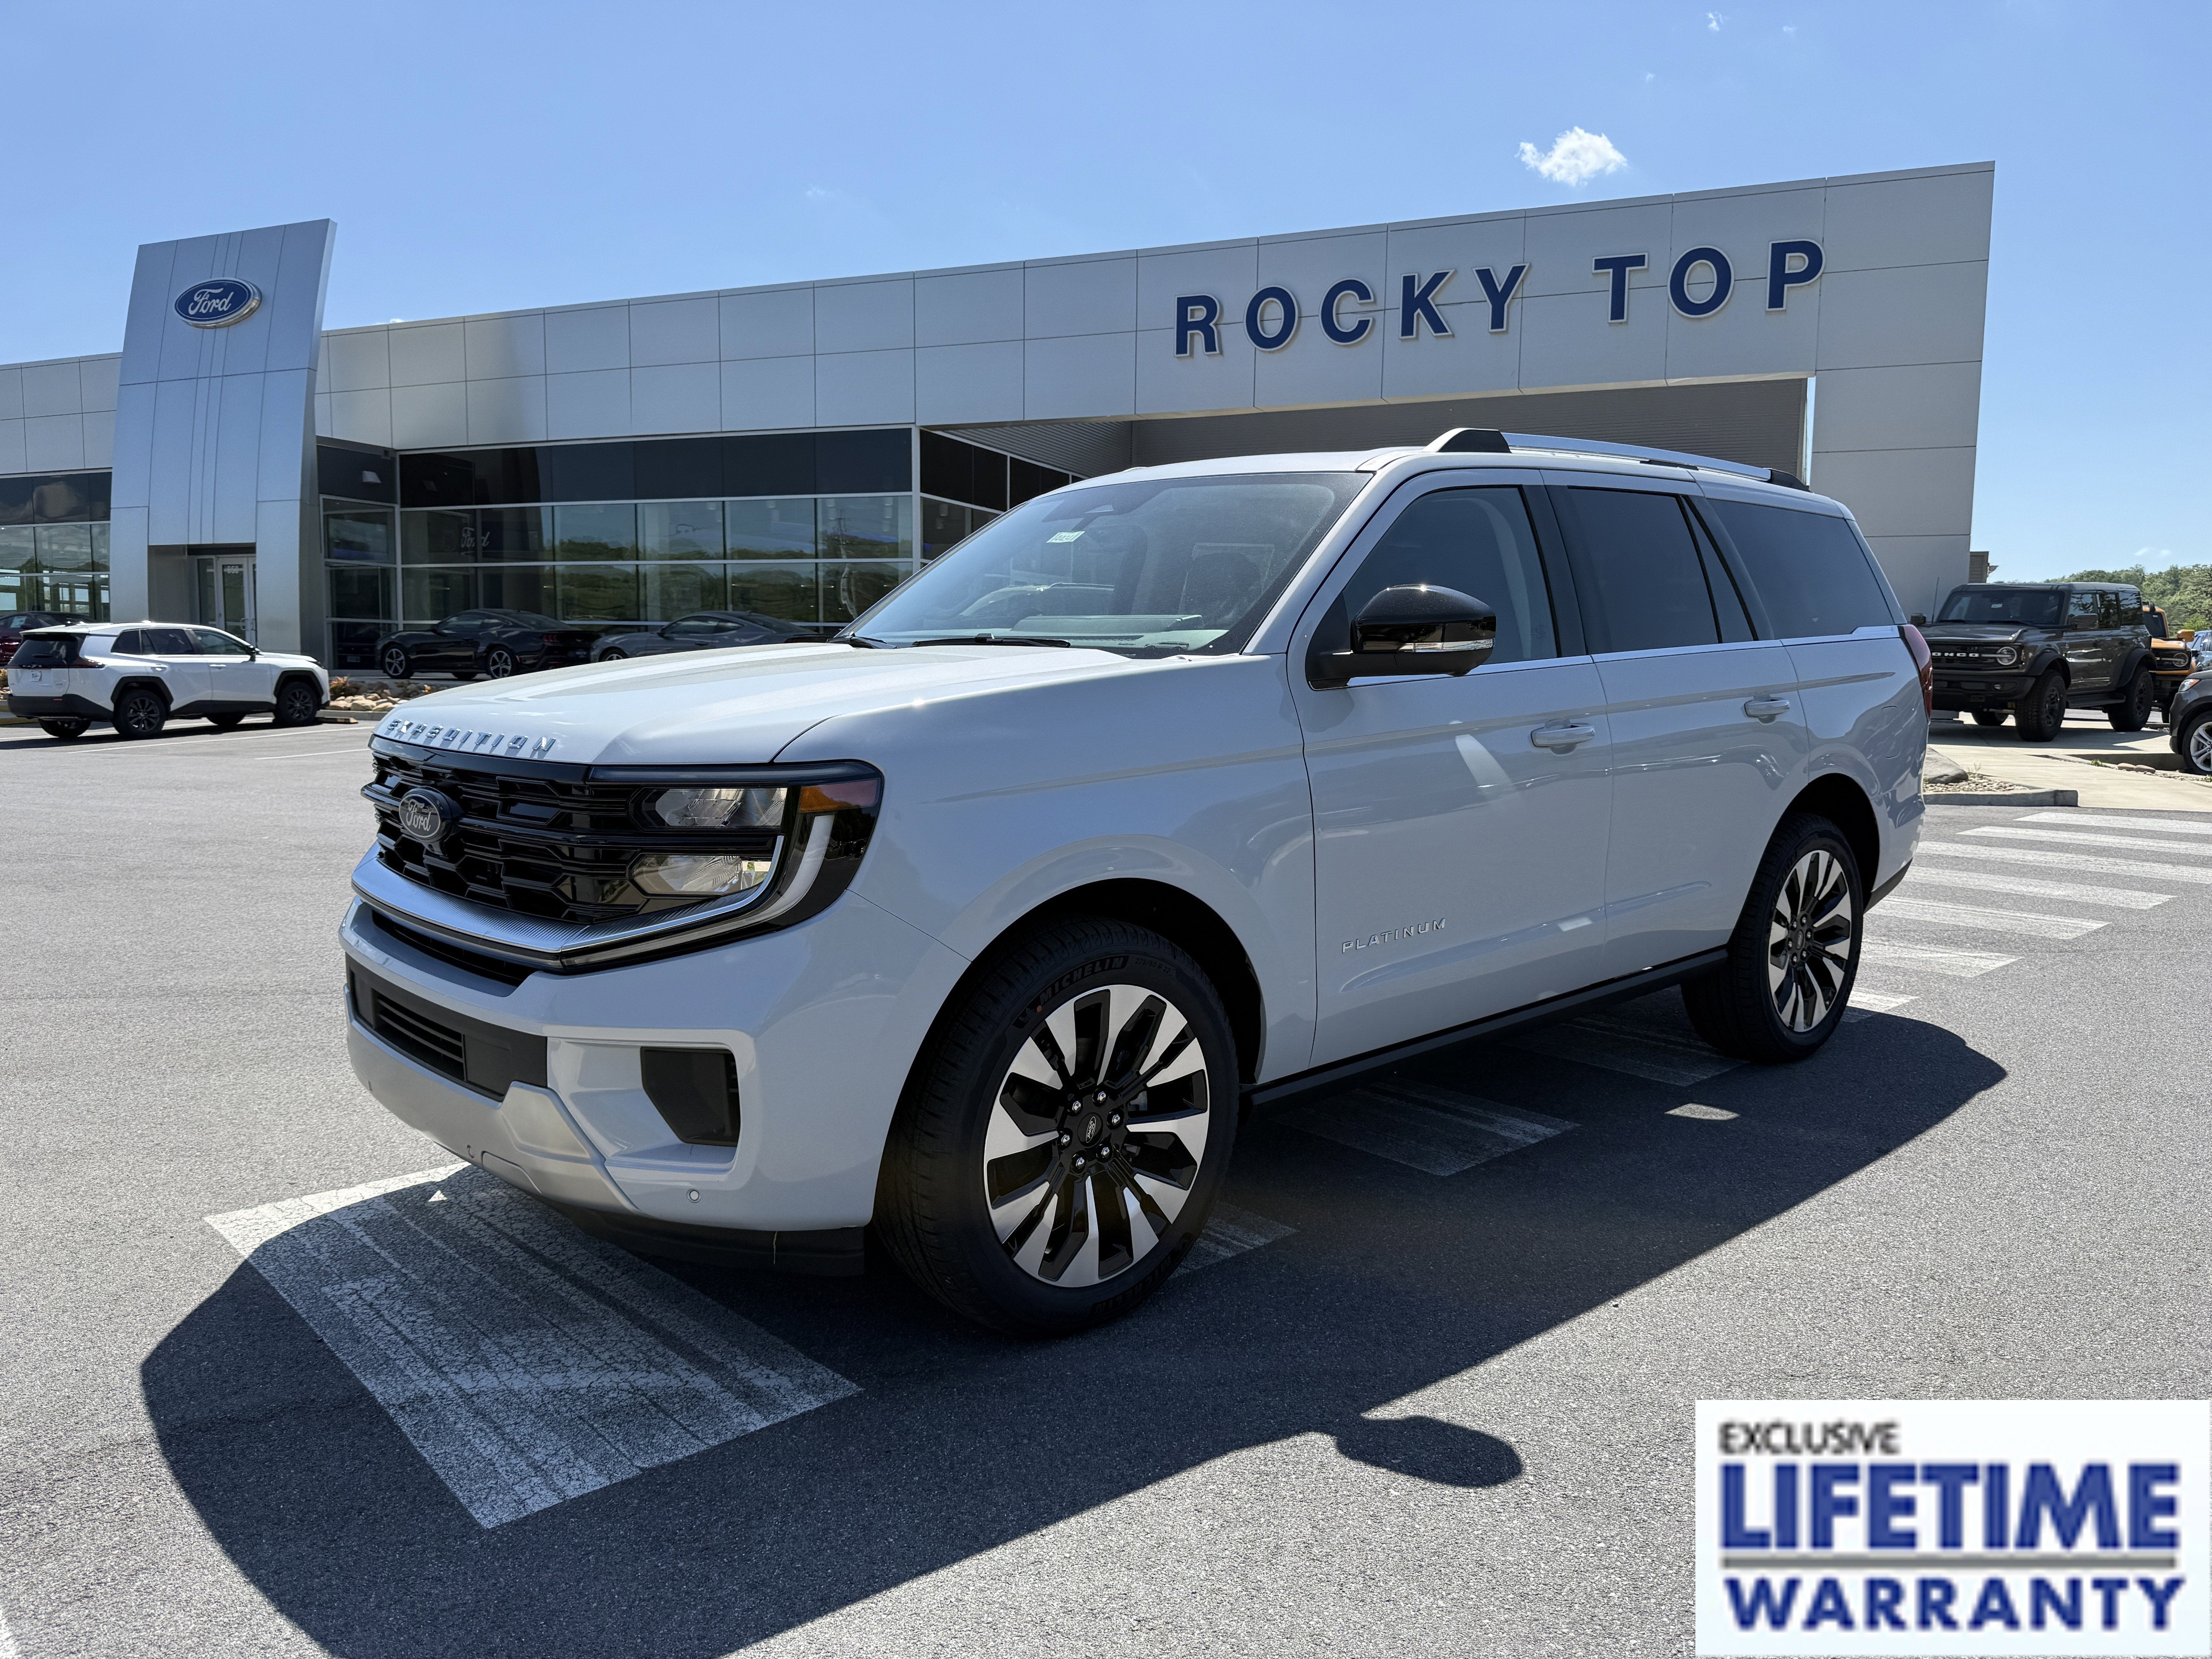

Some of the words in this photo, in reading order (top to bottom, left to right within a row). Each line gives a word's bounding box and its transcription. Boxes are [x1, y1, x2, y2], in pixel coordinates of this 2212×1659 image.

[188, 287, 234, 315] Ford
[1174, 263, 1530, 357] ROCKY
[1592, 238, 1826, 323] TOP
[387, 718, 556, 752] EXPEDITION
[407, 799, 431, 831] Ford
[1341, 917, 1446, 954] PLATINUM
[1135, 958, 1157, 967] 275/50
[1039, 957, 1124, 1006] MICHELIN
[1087, 1121, 1095, 1139] Ford
